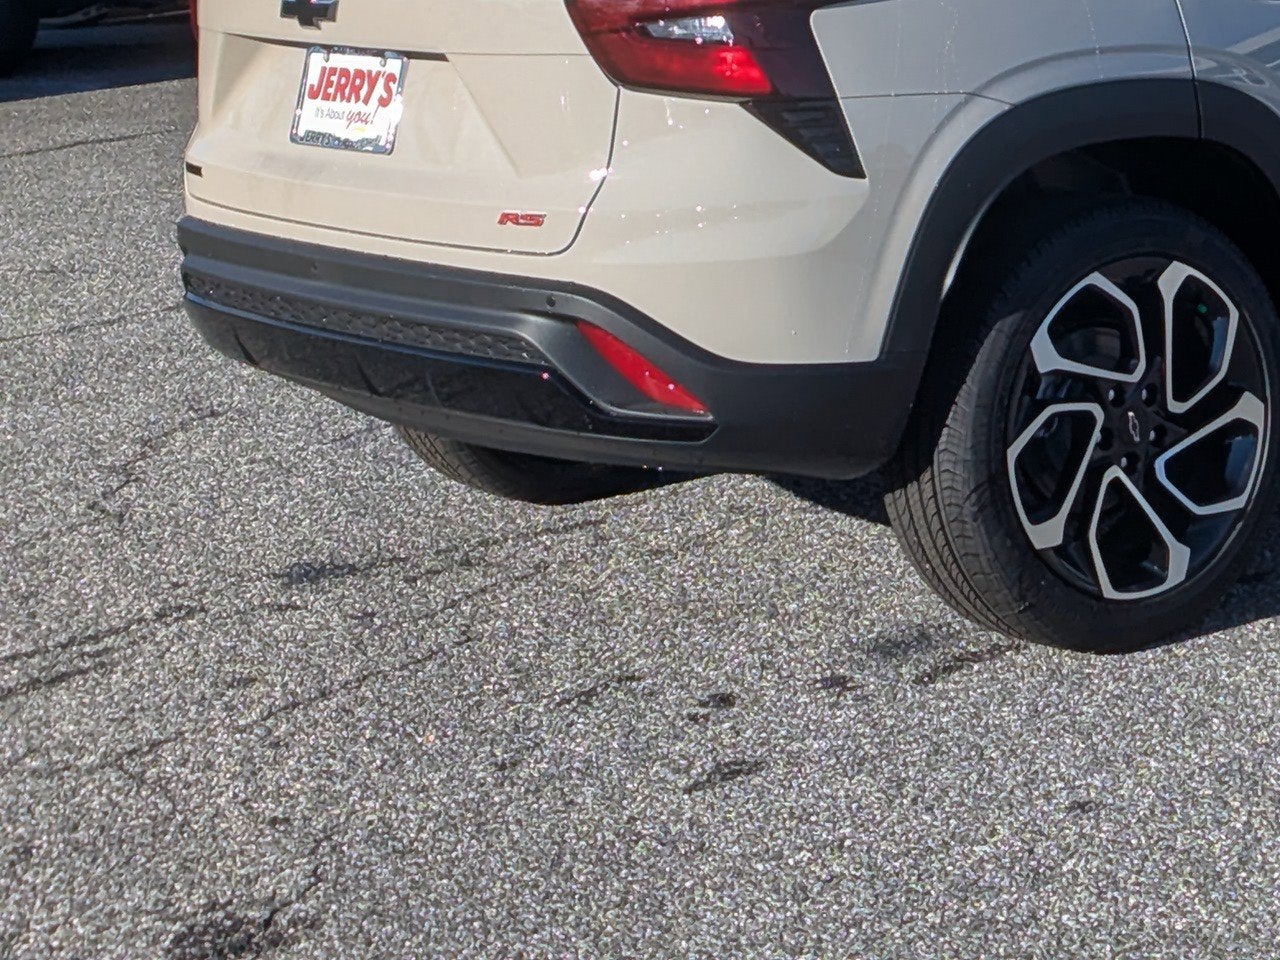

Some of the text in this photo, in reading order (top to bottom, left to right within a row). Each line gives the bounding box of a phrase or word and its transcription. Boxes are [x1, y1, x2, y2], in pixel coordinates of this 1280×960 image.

[308, 66, 397, 107] JERRY'S
[326, 107, 345, 120] About
[497, 212, 547, 227] RS
